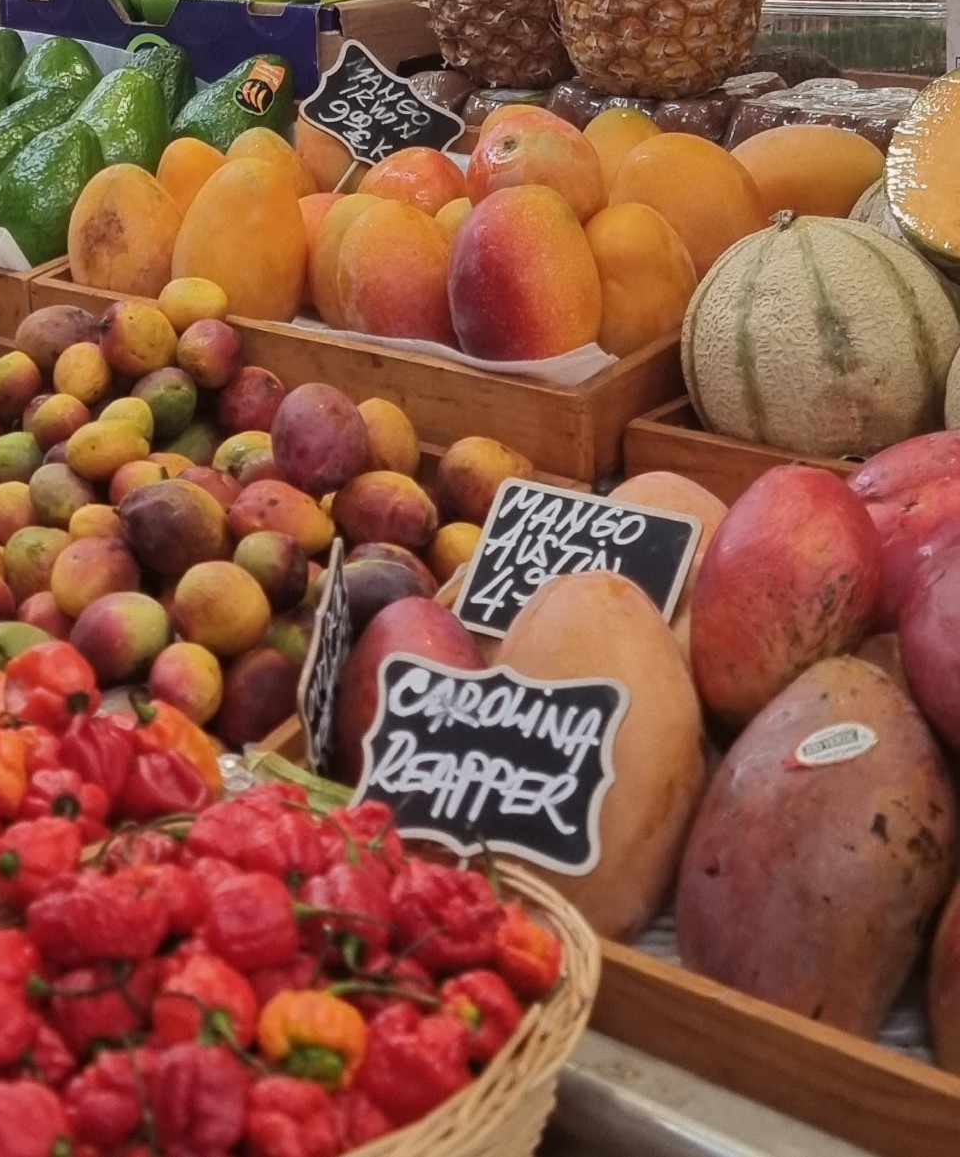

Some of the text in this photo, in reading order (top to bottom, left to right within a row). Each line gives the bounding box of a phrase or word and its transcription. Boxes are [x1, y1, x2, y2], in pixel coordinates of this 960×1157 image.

[339, 84, 421, 140] IRWIN
[345, 56, 431, 126] MANGO
[498, 485, 647, 546] MANGO
[367, 729, 579, 836] REAPPER
